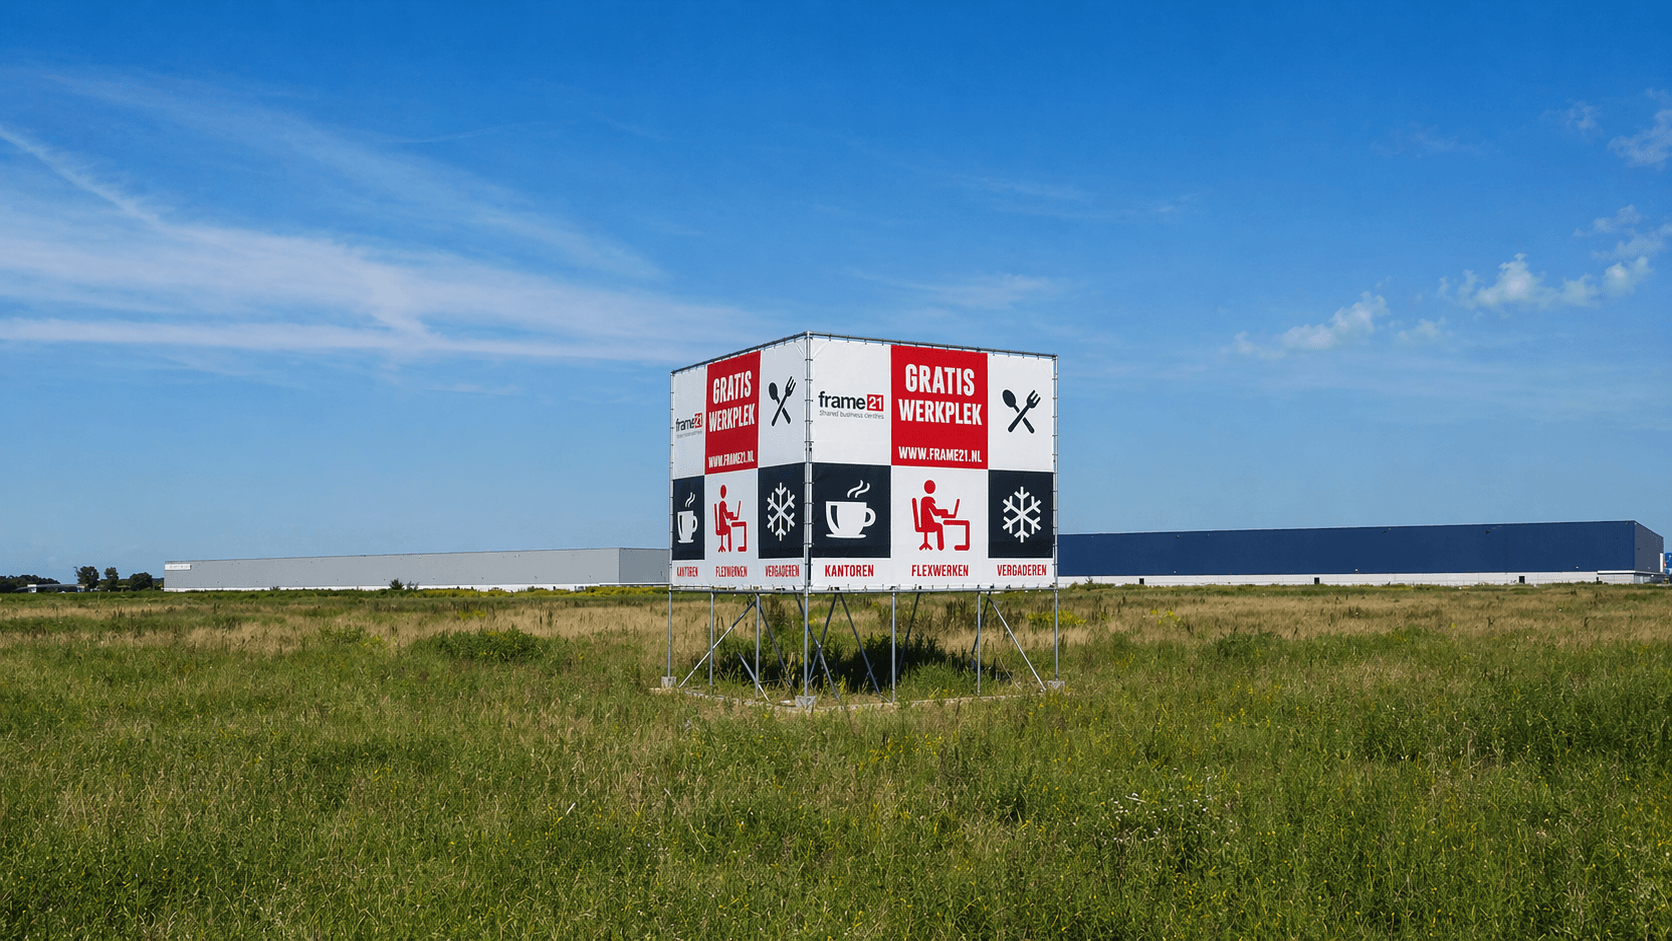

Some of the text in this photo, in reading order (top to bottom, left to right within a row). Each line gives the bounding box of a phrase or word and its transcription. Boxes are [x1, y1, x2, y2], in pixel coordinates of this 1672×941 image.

[712, 370, 752, 405] GRATIS
[905, 363, 975, 397] GRATIS
[708, 403, 756, 433] WERKPLEK
[898, 398, 983, 426] WERKPLEK
[898, 446, 983, 463] WWW.FRAME21.NL
[824, 564, 875, 578] KANTOREN
[911, 564, 970, 578] FLEXWERKEN
[996, 563, 1048, 577] VERGADEREN
